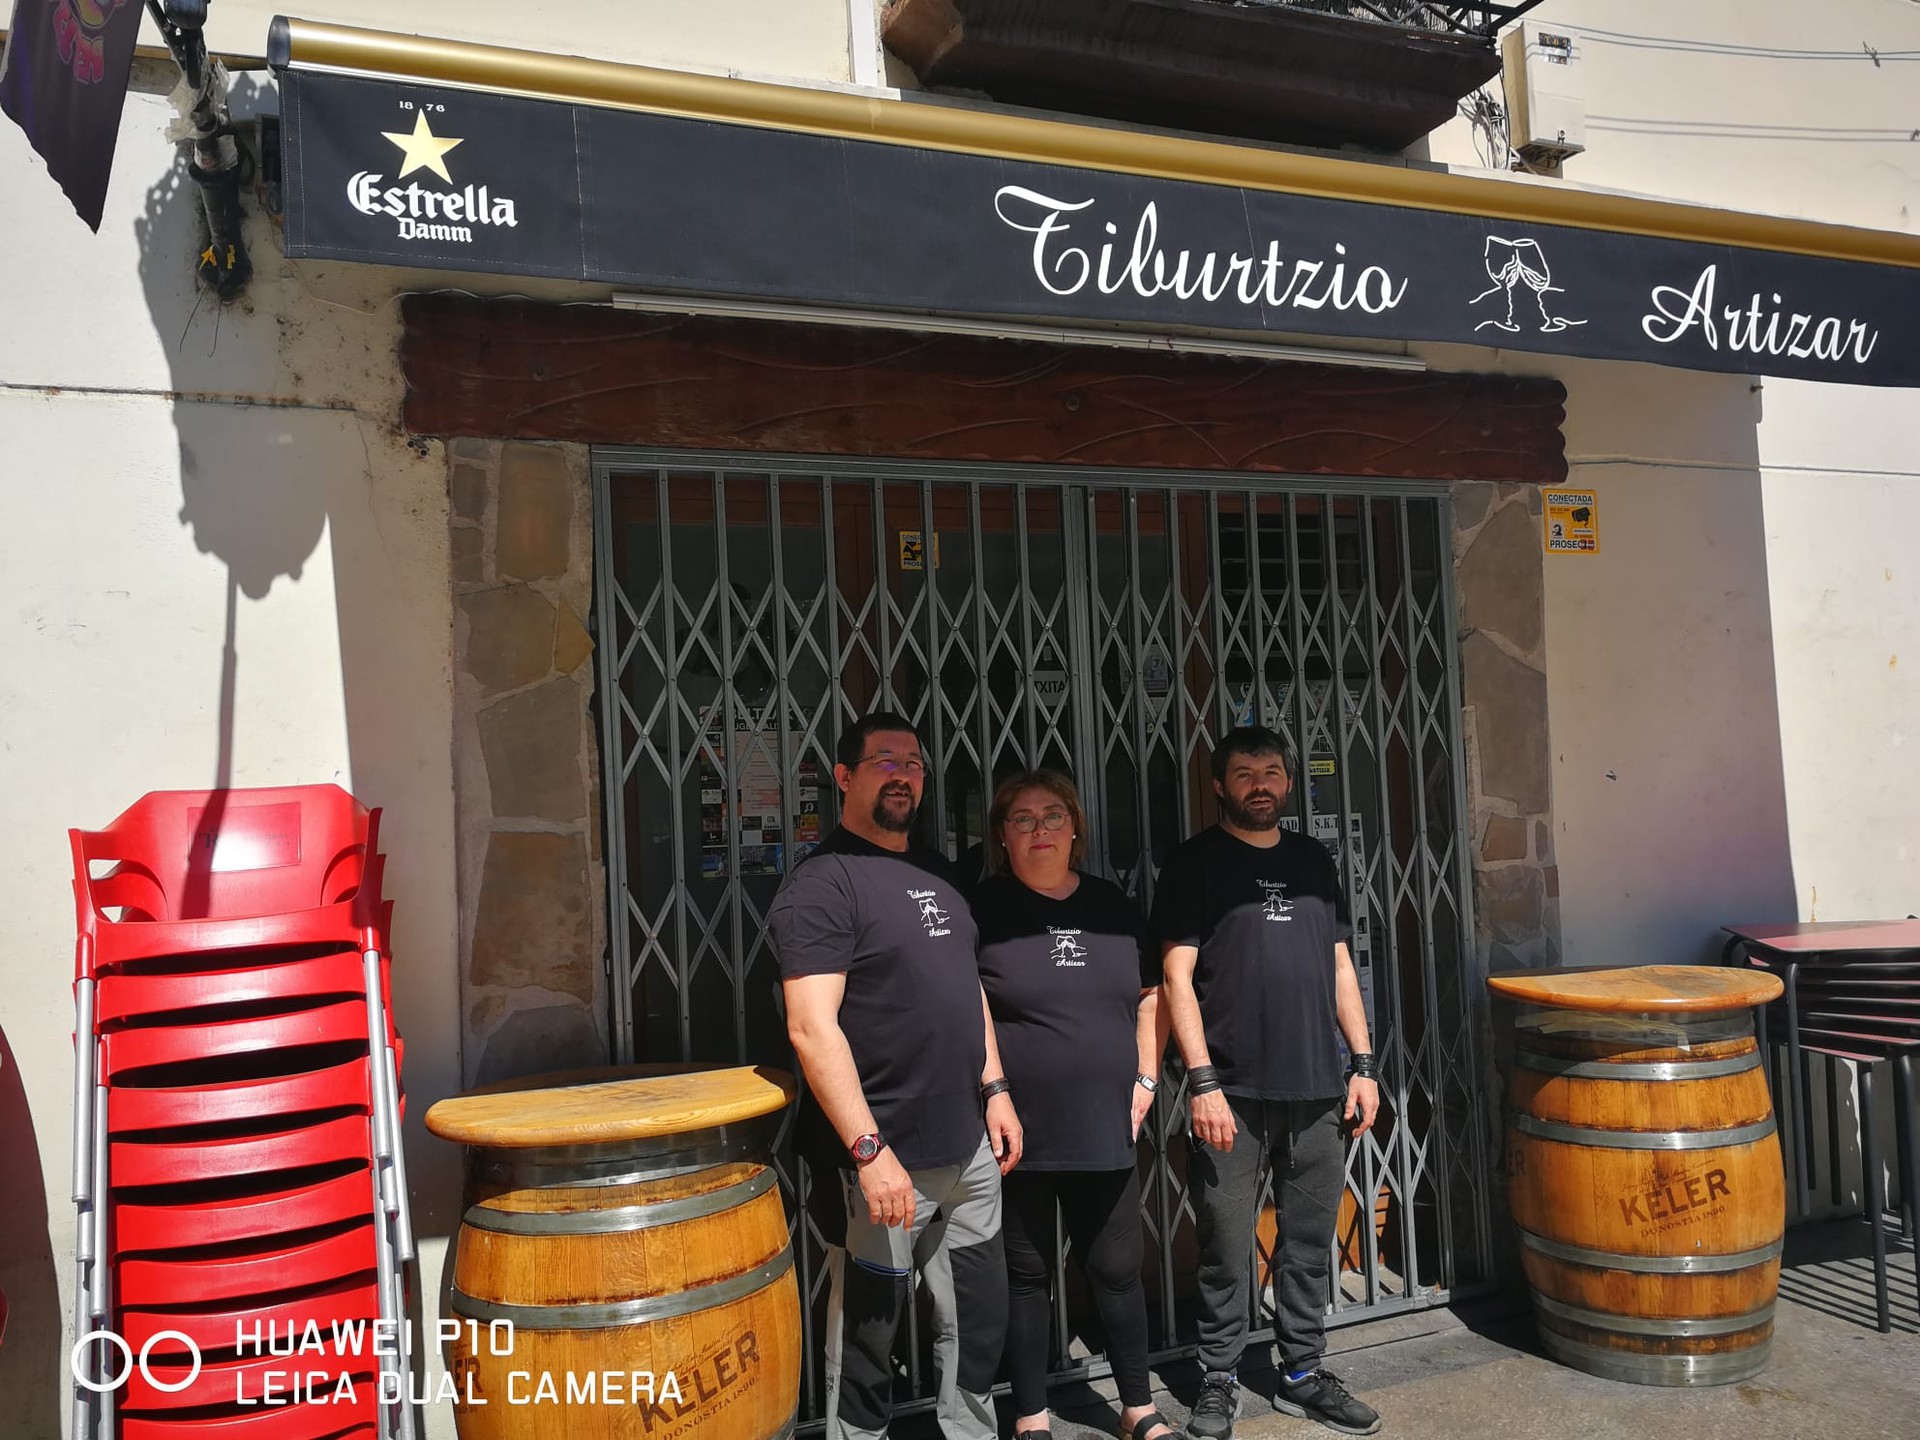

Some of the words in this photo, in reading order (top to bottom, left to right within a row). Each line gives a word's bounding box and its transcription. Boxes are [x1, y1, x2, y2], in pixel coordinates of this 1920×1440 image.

[399, 100, 414, 110] 18
[425, 103, 446, 113] 76
[346, 170, 519, 228] Estrella
[397, 216, 473, 243] Damm
[994, 185, 1408, 314] Tiburtzio
[1641, 264, 1879, 363] Artizar
[1547, 493, 1593, 503] CONECTADA
[1618, 1168, 1732, 1227] KELER
[637, 1330, 760, 1434] KELER
[662, 1397, 732, 1440] DONOSTIA
